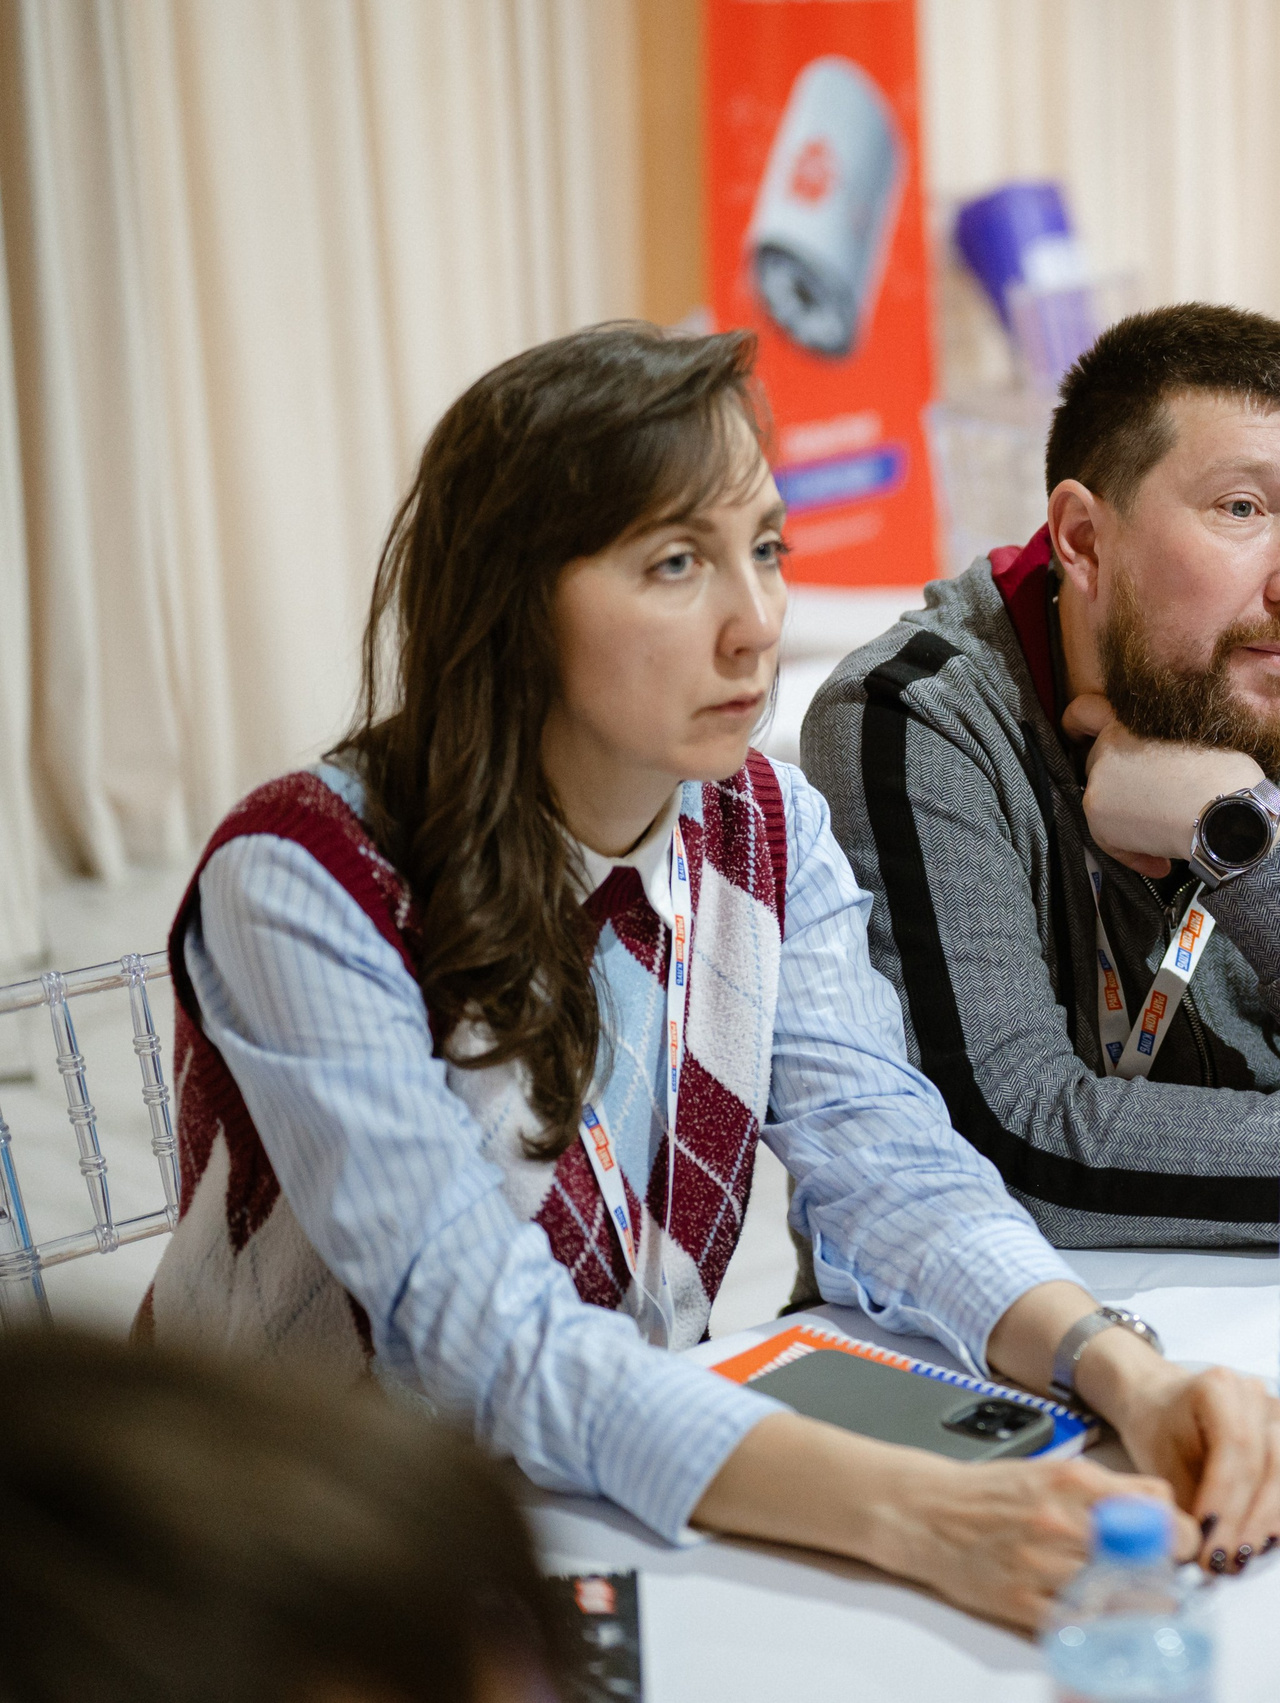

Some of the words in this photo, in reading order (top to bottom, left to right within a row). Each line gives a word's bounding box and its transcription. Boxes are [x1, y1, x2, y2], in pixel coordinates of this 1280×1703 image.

[1188, 911, 1202, 936] PART
[1180, 929, 1194, 951] KOM
[1176, 948, 1191, 971] КЛУБ
[1105, 971, 1117, 988] KOM
[1105, 988, 1121, 1009] PART
[1151, 992, 1166, 1017] PART
[1143, 1011, 1158, 1033] KOM
[1138, 1031, 1154, 1055] КЛУБ
